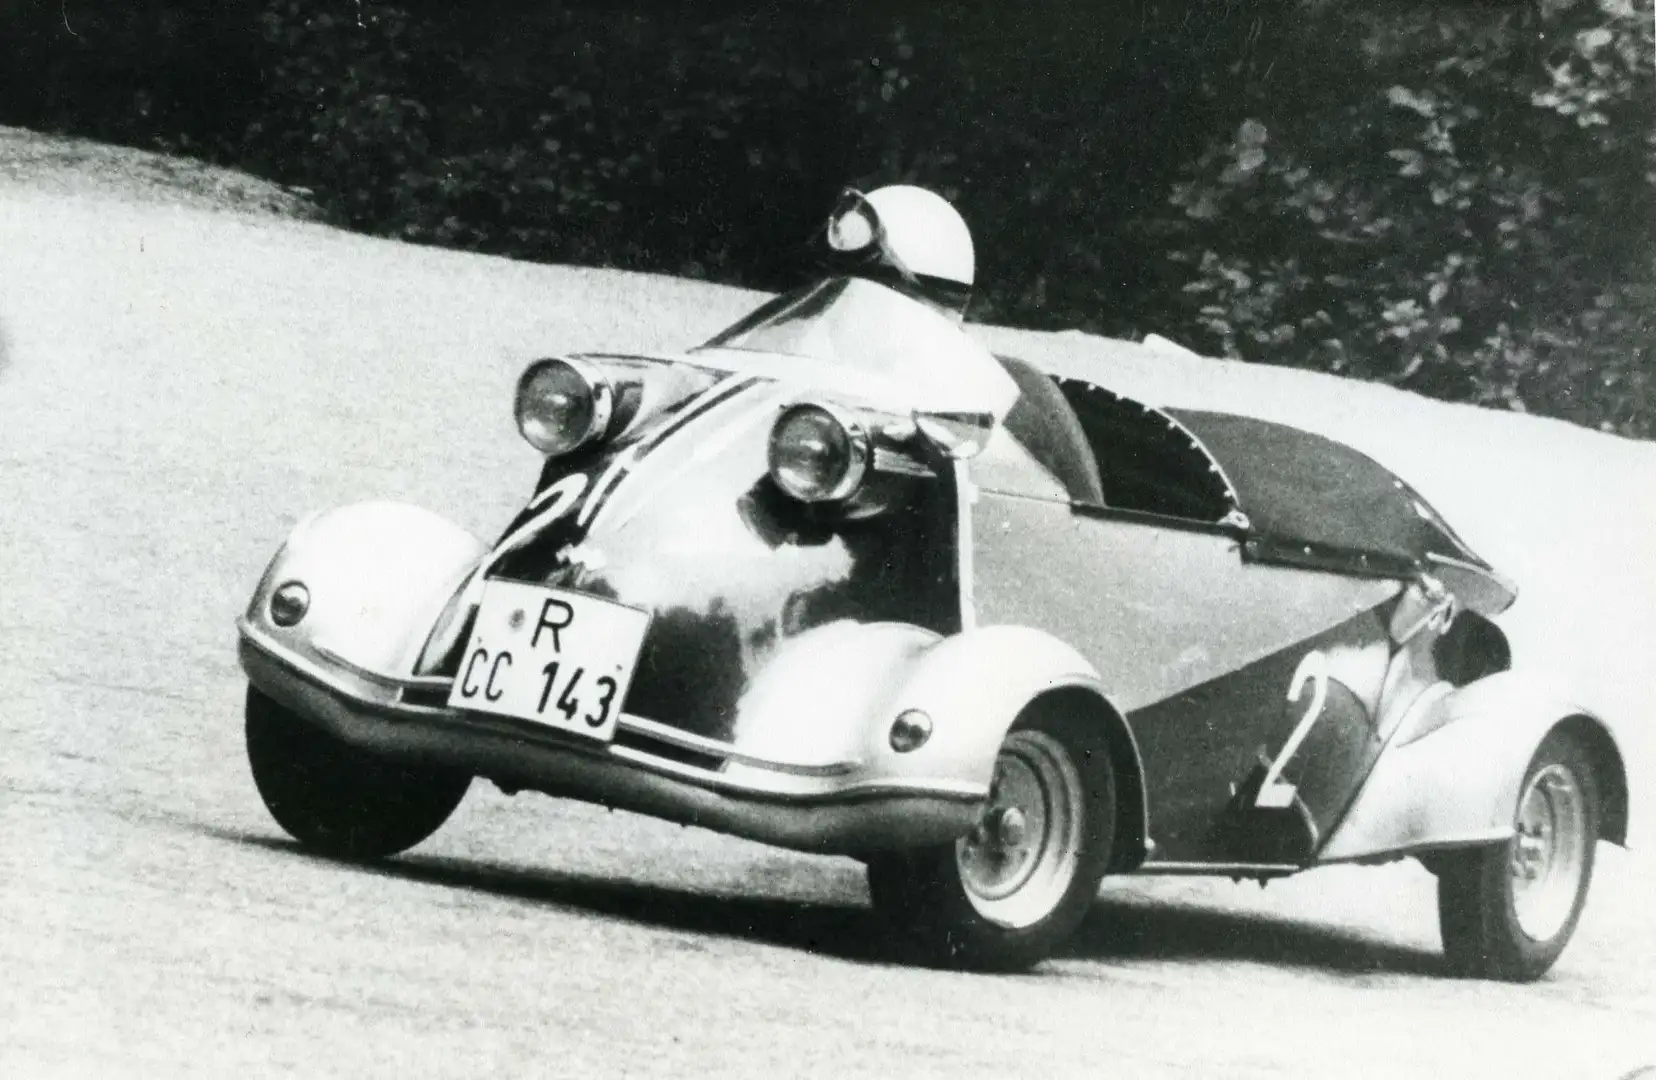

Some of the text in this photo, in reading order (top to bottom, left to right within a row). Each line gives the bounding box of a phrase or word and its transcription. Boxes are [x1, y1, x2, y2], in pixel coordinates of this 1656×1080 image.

[531, 598, 574, 653] R
[461, 648, 617, 728] CC 143
[1254, 650, 1328, 807] 2
